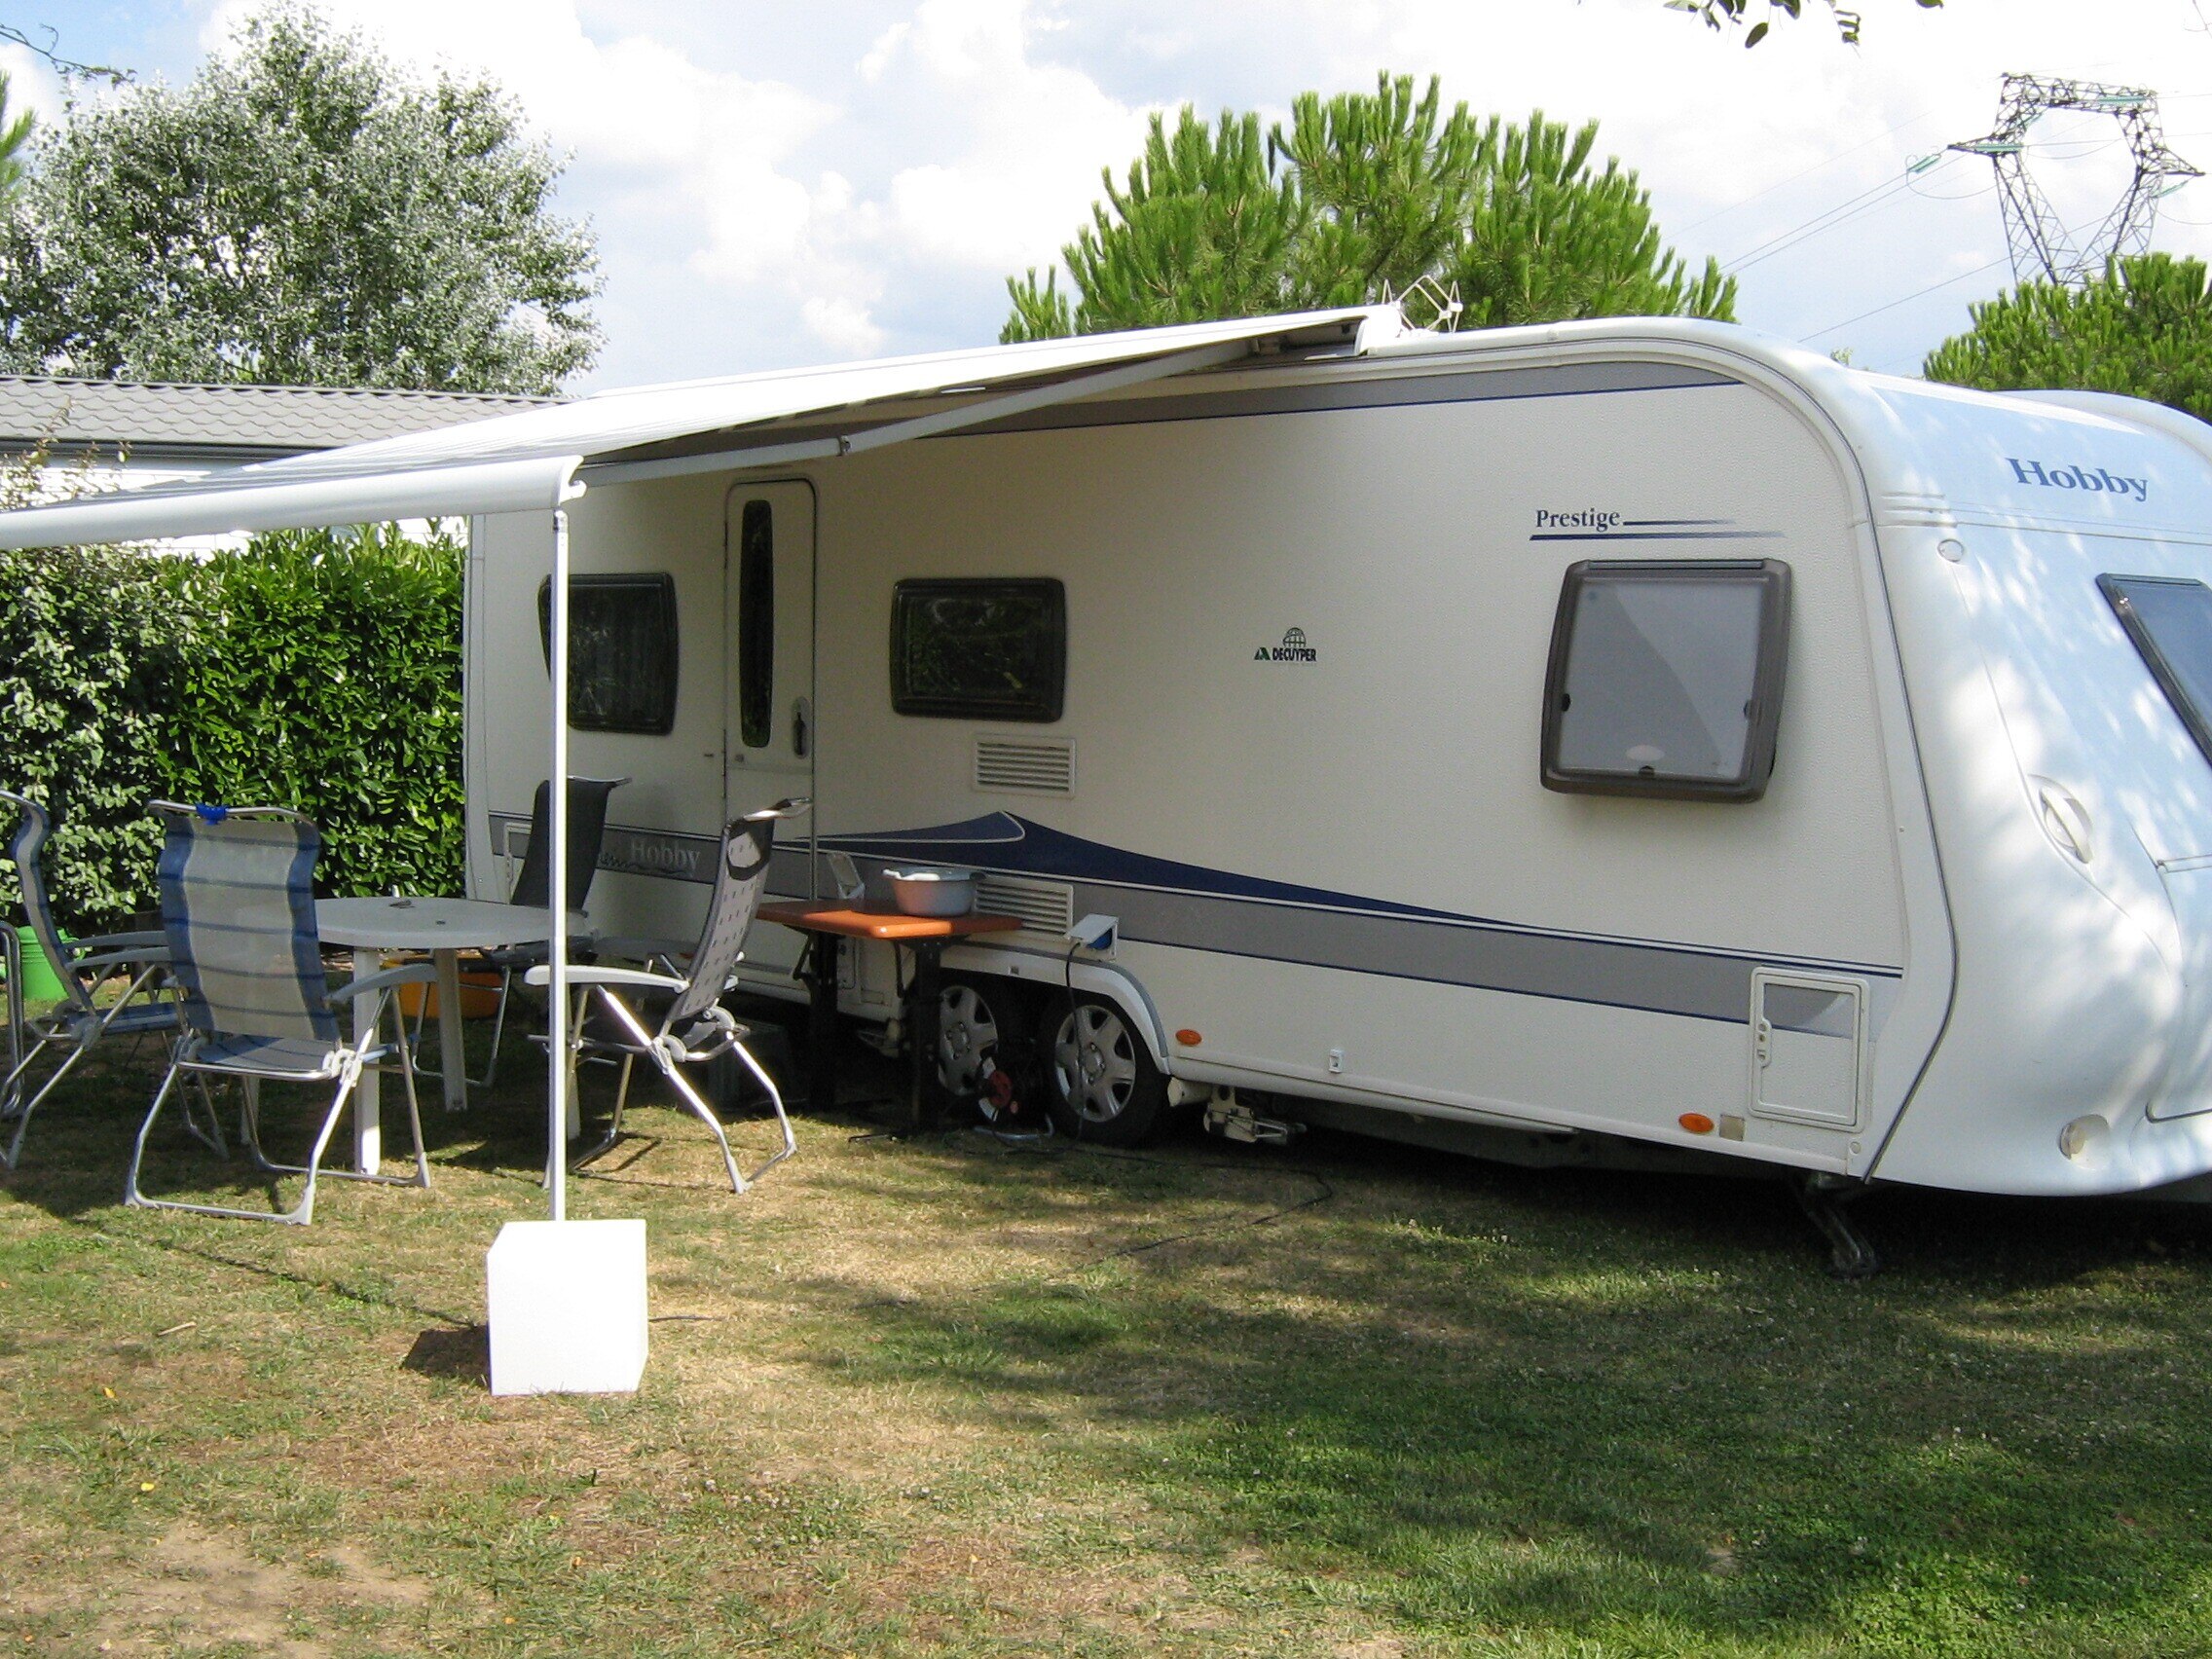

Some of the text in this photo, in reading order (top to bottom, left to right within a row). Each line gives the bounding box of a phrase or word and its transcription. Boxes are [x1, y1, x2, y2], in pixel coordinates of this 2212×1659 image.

[2006, 457, 2148, 502] Hobby
[1535, 508, 1621, 532] Prestige
[629, 835, 701, 878] Hobby
